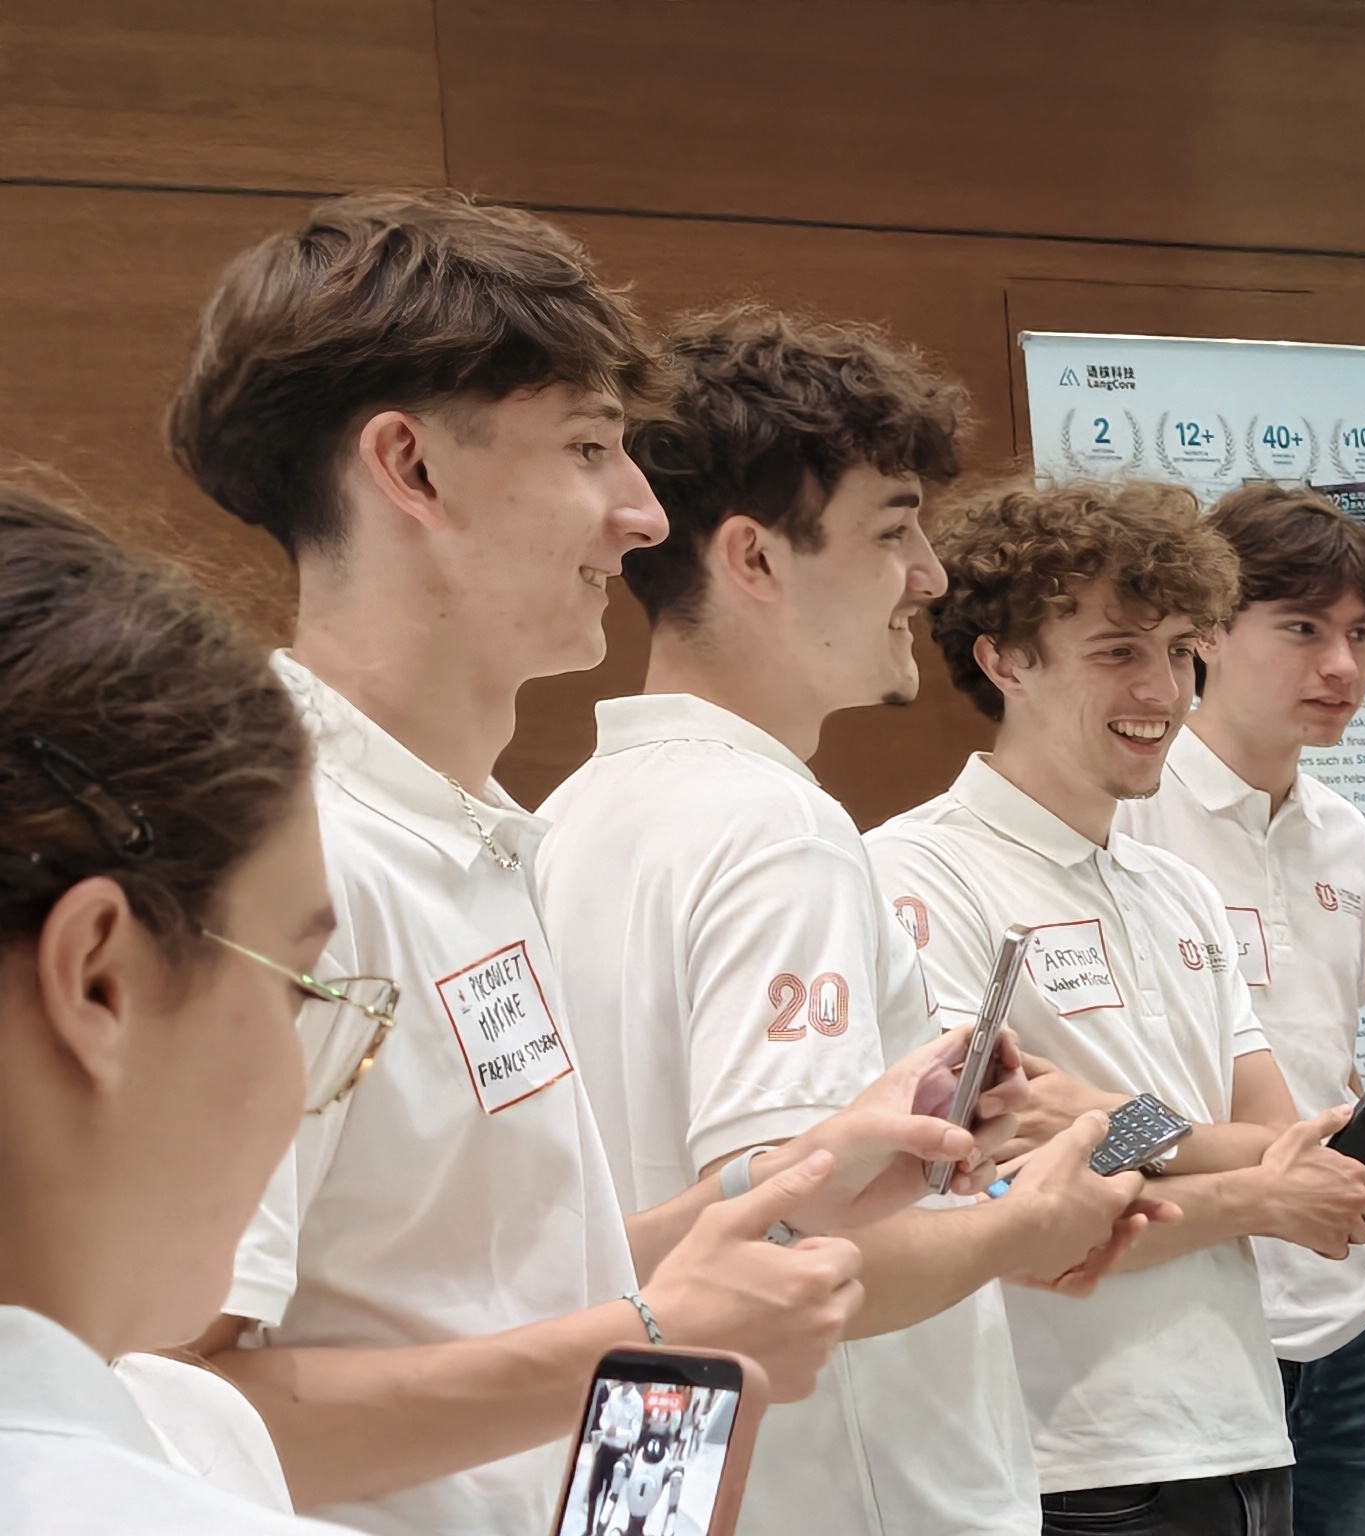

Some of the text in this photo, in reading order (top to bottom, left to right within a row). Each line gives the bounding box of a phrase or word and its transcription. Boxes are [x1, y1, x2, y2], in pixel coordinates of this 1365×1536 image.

[1087, 379, 1136, 391] LangCore
[1093, 418, 1111, 444] 2
[1175, 422, 1215, 446] 12+
[1262, 425, 1303, 449] 40+
[1315, 756, 1340, 766] such
[1044, 946, 1105, 971] ARTHUR
[767, 972, 849, 1042] 20
